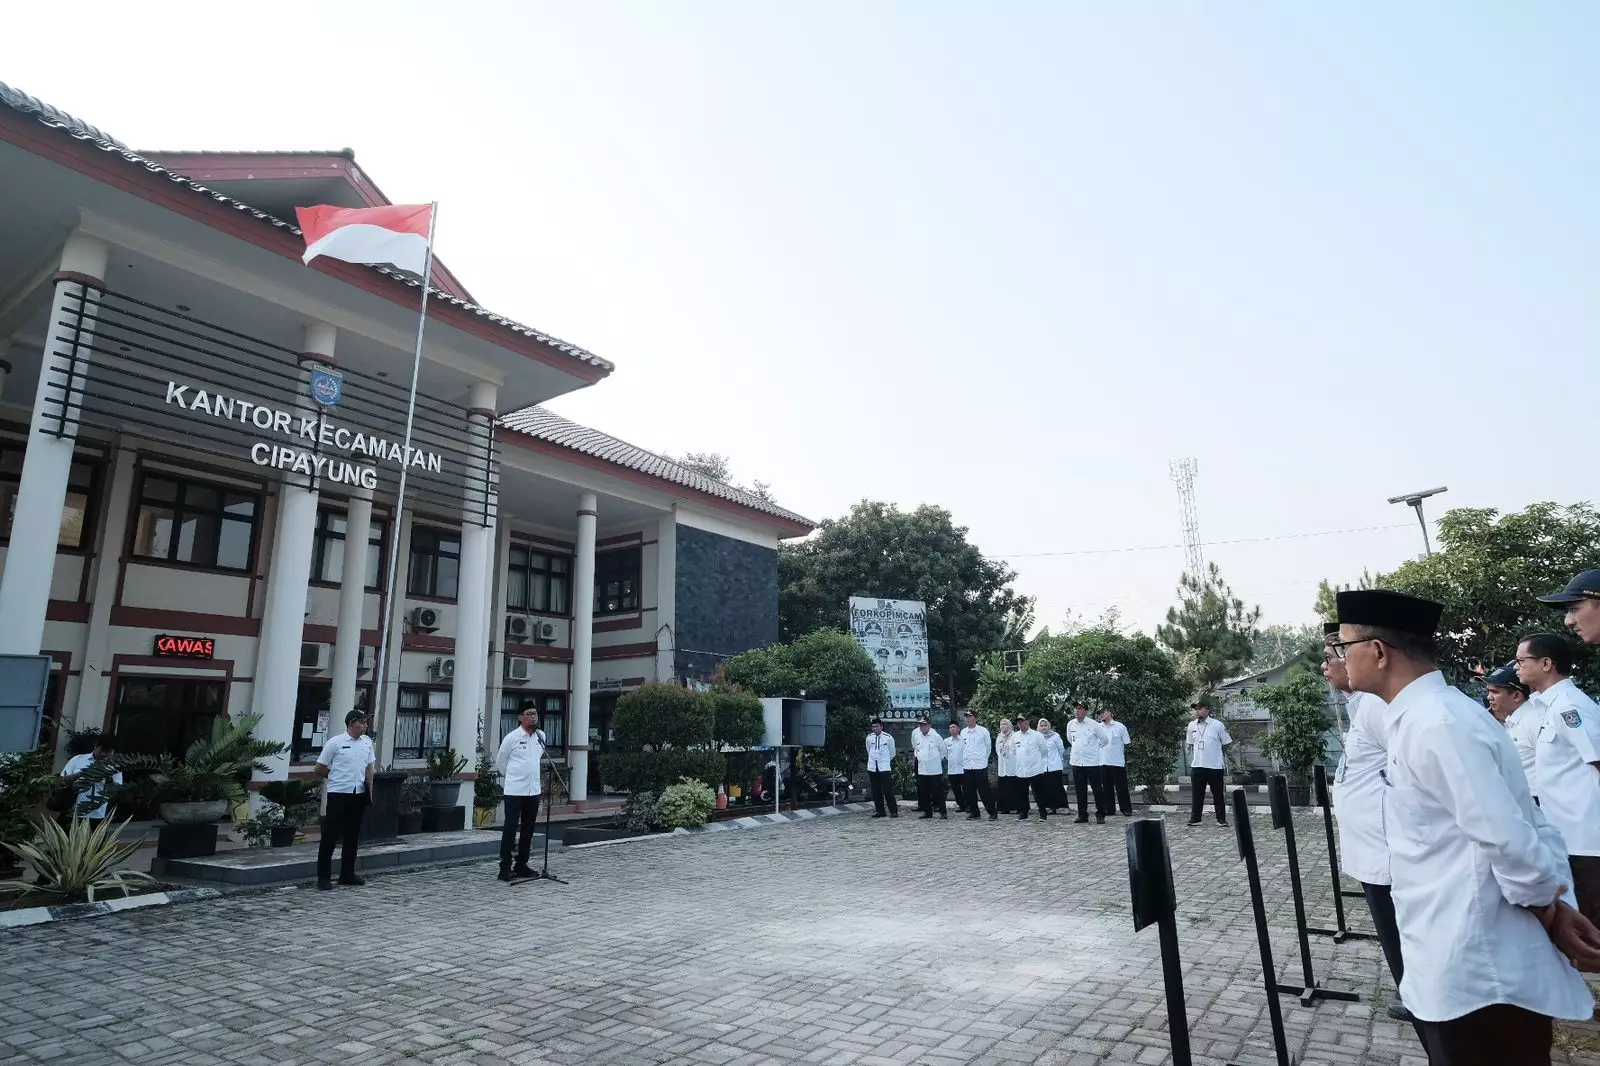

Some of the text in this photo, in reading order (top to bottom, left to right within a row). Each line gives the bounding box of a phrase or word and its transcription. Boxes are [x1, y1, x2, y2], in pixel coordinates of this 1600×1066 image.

[165, 381, 442, 473] KANTOR KECAMATAN
[251, 442, 378, 489] CIPAYUNG
[854, 608, 922, 621] FORKOPIMCAM
